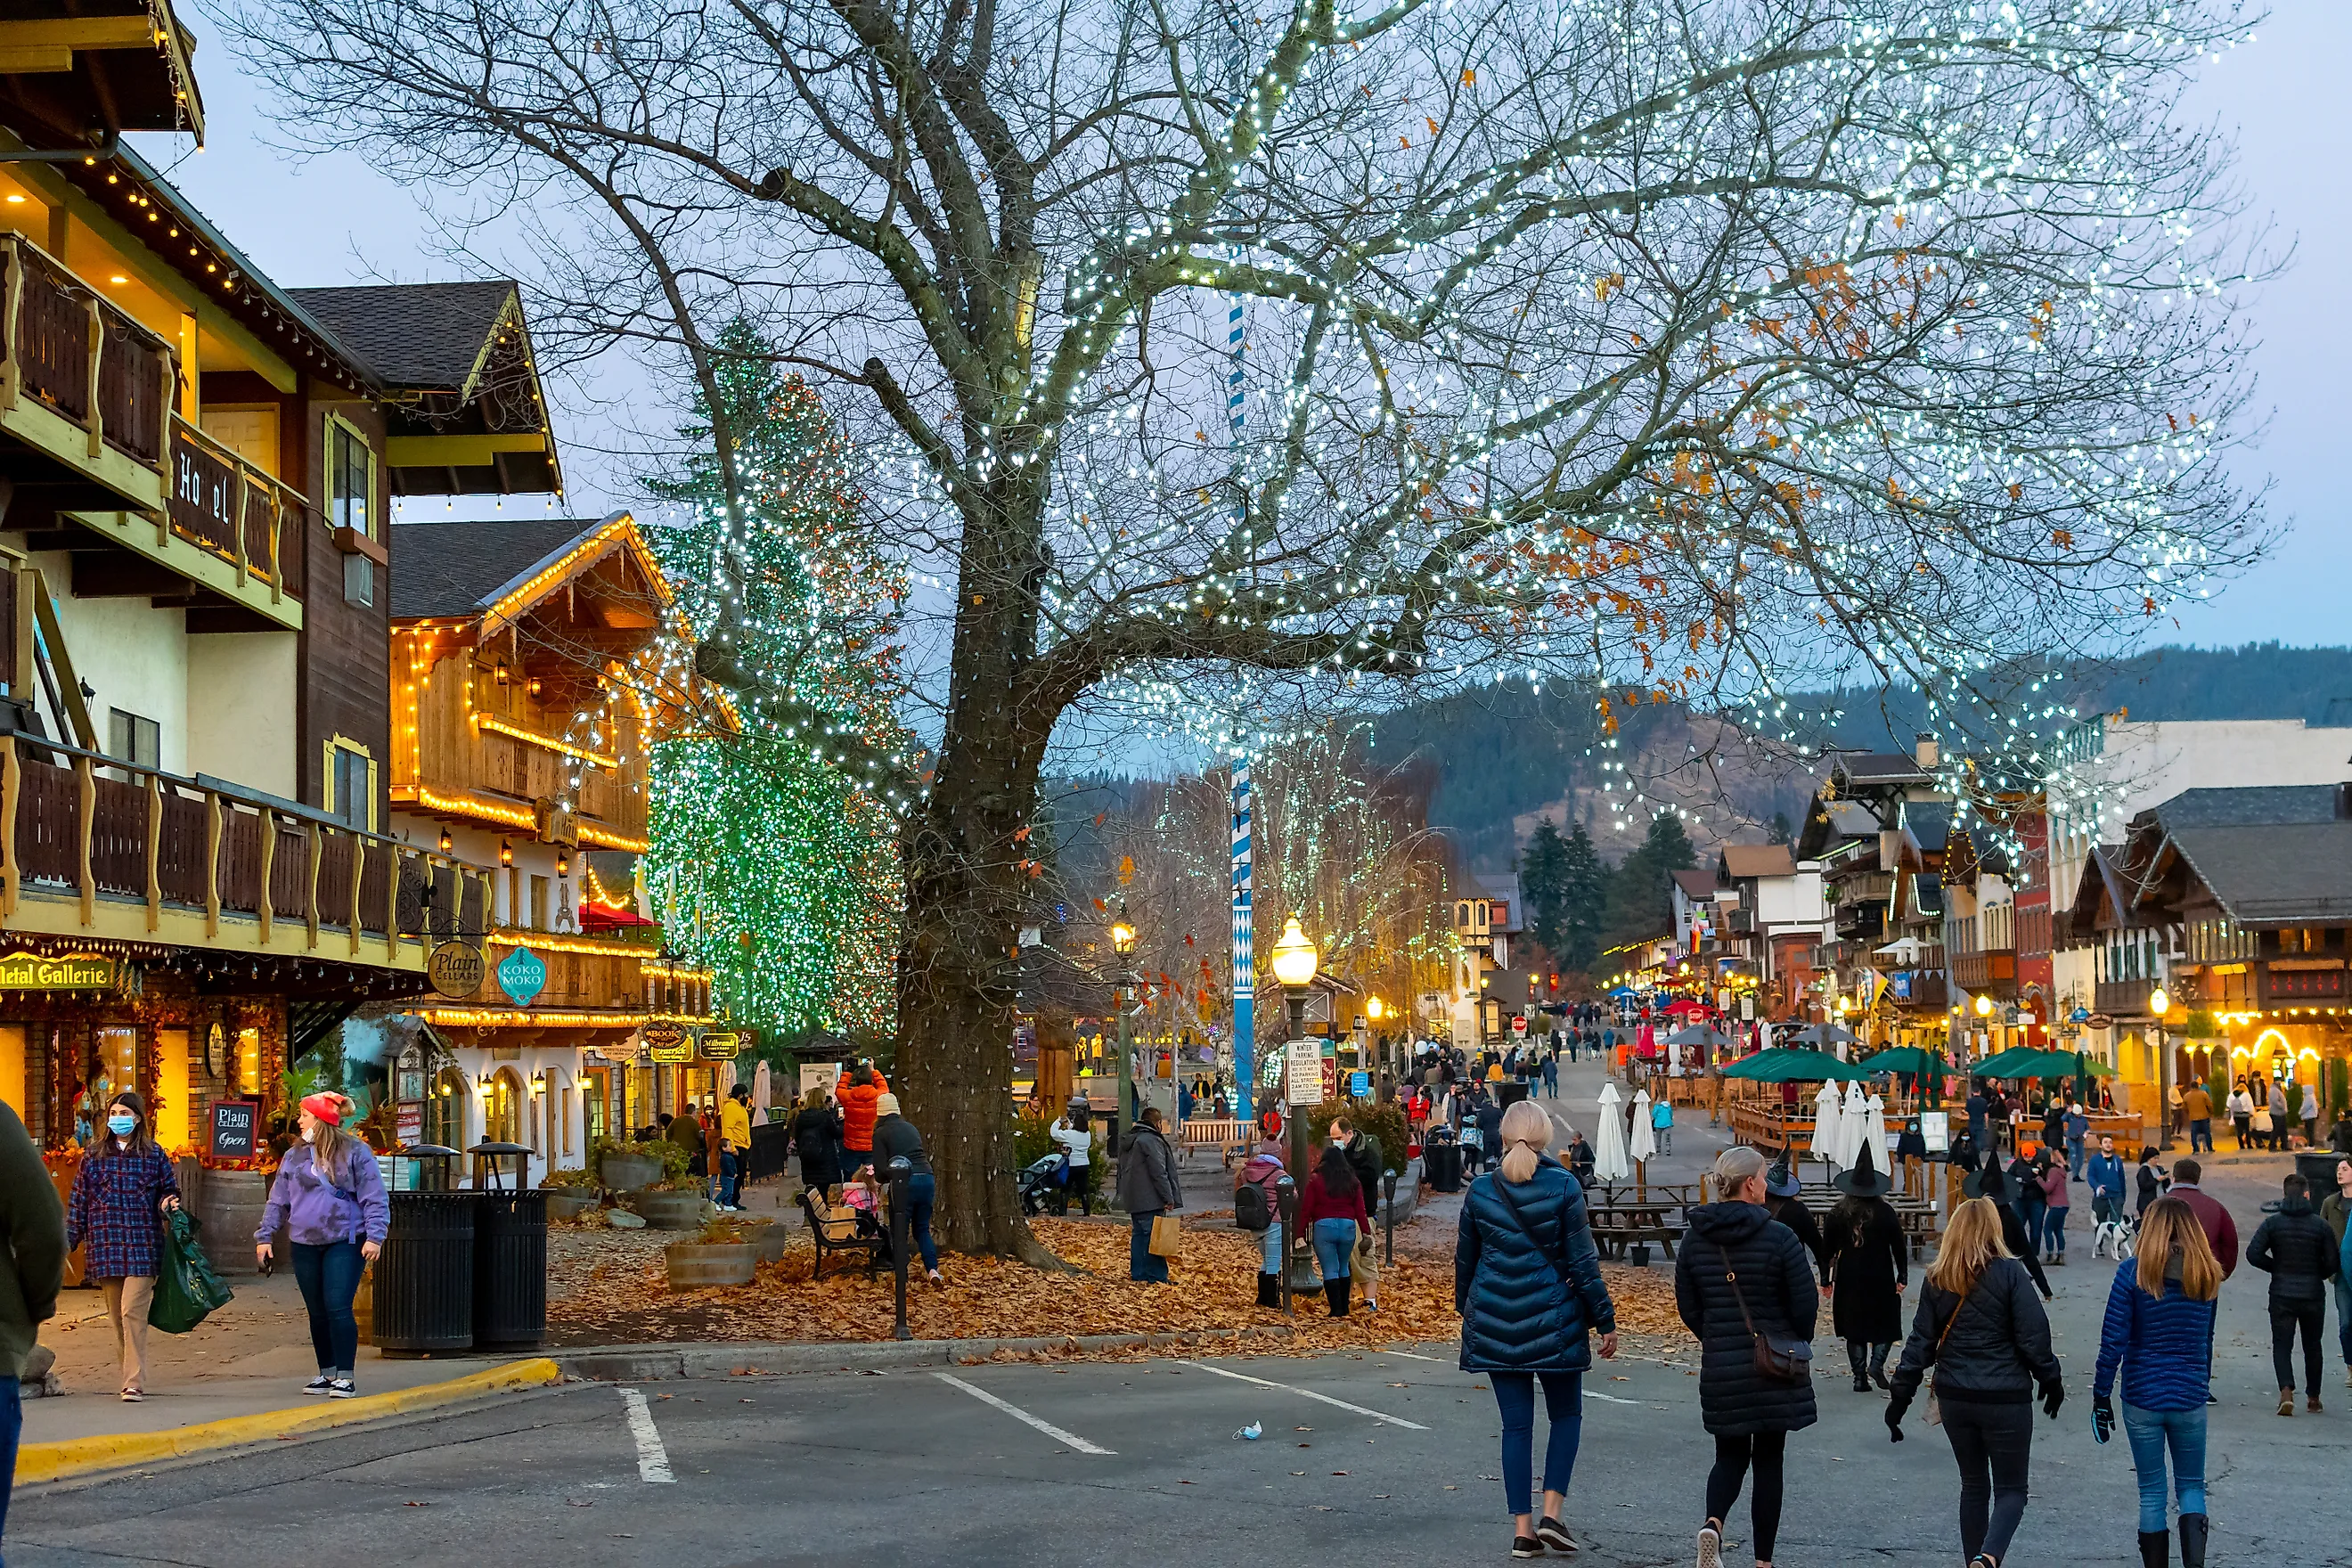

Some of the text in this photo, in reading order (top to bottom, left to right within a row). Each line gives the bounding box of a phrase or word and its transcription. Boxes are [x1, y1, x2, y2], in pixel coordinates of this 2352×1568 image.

[180, 452, 229, 525] Hoel
[435, 951, 478, 971] Plain
[37, 963, 107, 984] Gallerie
[435, 970, 478, 981] CELLARS
[502, 965, 541, 976] KOKO
[502, 976, 541, 985] MOKO
[219, 1109, 249, 1123] Plain
[219, 1132, 246, 1149] Open
